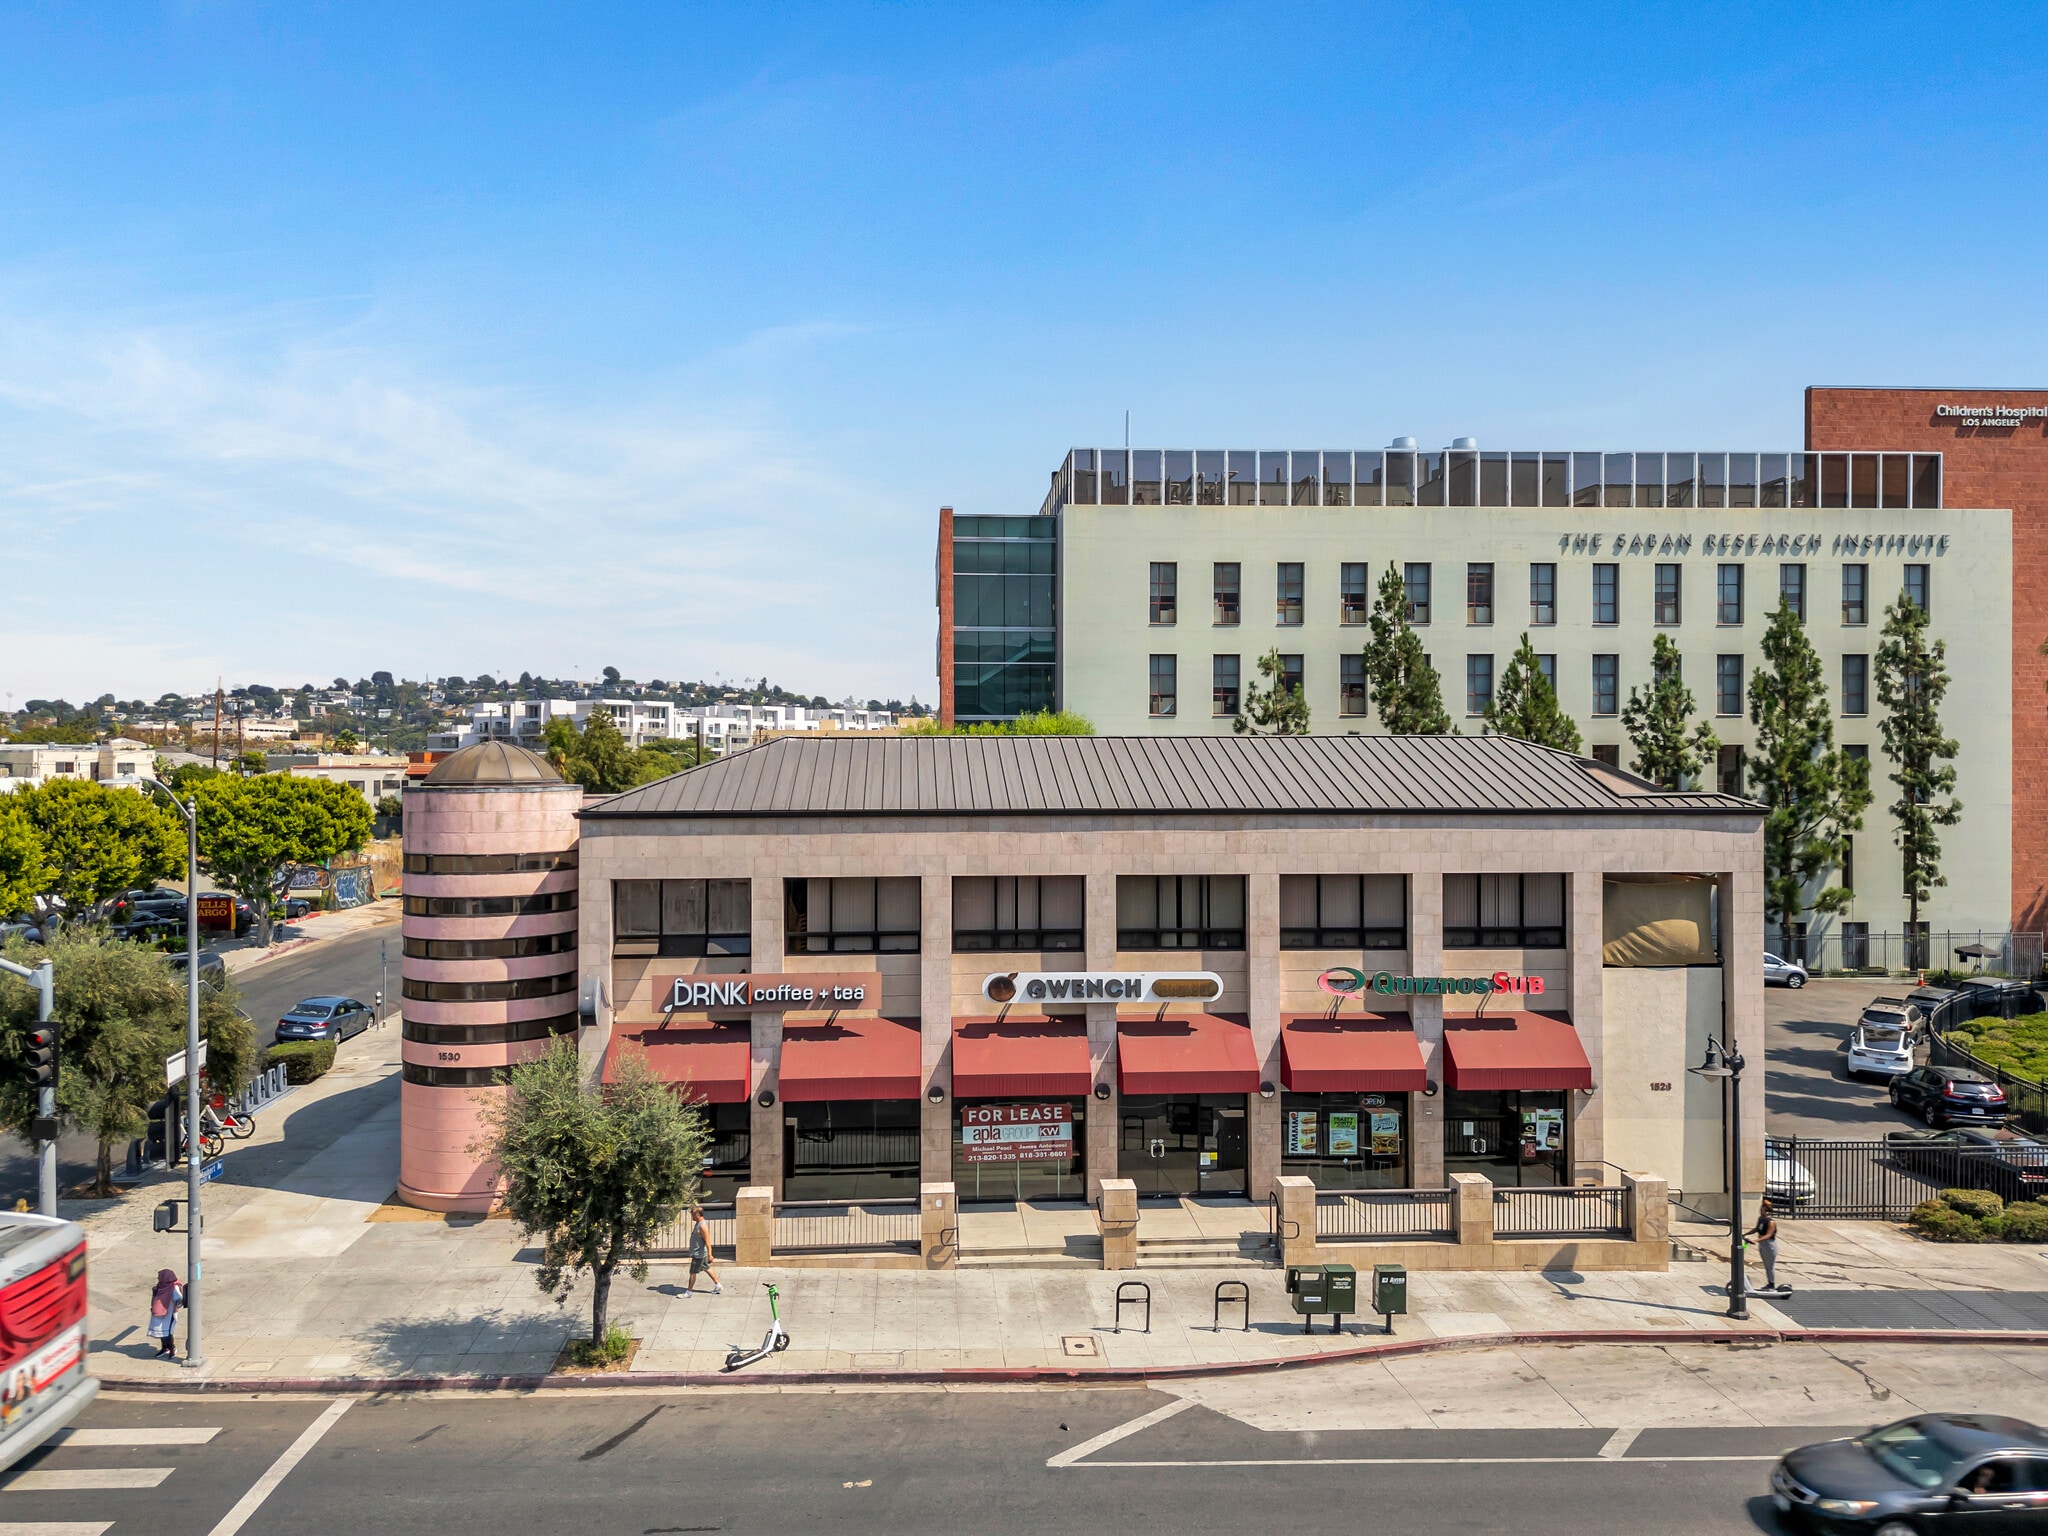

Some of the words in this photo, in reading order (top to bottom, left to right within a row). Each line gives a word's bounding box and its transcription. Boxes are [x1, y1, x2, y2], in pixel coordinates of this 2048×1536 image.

[1936, 404, 1993, 417] Children's
[1996, 405, 2048, 421] Hospital
[1962, 418, 1980, 426] LOS
[1981, 418, 2021, 427] ANGELES
[1562, 533, 1604, 549] THE
[1617, 533, 1693, 549] SABAN
[1706, 533, 1823, 549] RESEARCH
[1835, 533, 1952, 549] INSTITUTE
[197, 909, 227, 917] ARGO
[673, 978, 747, 1007] DRNK
[754, 984, 814, 1001] coffee
[833, 985, 865, 1001] tea
[1026, 978, 1142, 999] QWENCH
[438, 1052, 461, 1061] 1530
[968, 1110, 1003, 1123] FOR
[1010, 1107, 1063, 1121] LEASE
[973, 1125, 1002, 1144] apla
[1002, 1126, 1034, 1140] GROUP
[1039, 1126, 1059, 1137] KW
